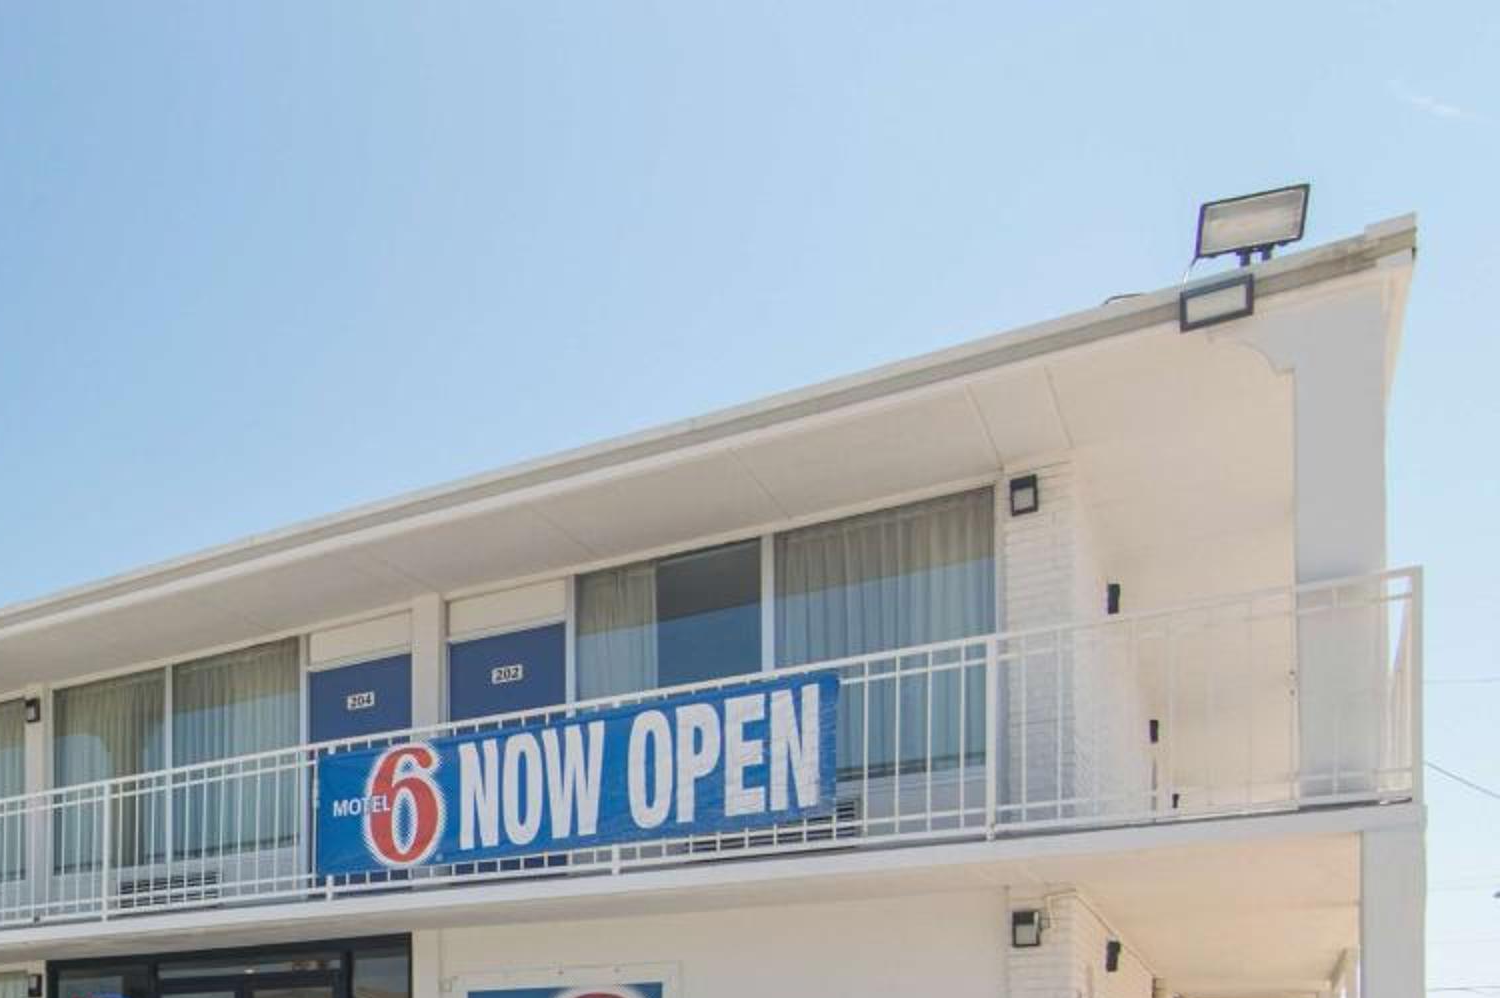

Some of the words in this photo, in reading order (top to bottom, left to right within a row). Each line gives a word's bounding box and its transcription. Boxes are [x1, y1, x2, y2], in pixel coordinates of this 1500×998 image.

[494, 666, 520, 682] 202
[349, 693, 373, 708] 204
[333, 795, 390, 817] MOTEL
[367, 744, 442, 865] 6
[459, 720, 605, 851] NOW
[626, 683, 821, 830] OPEN
